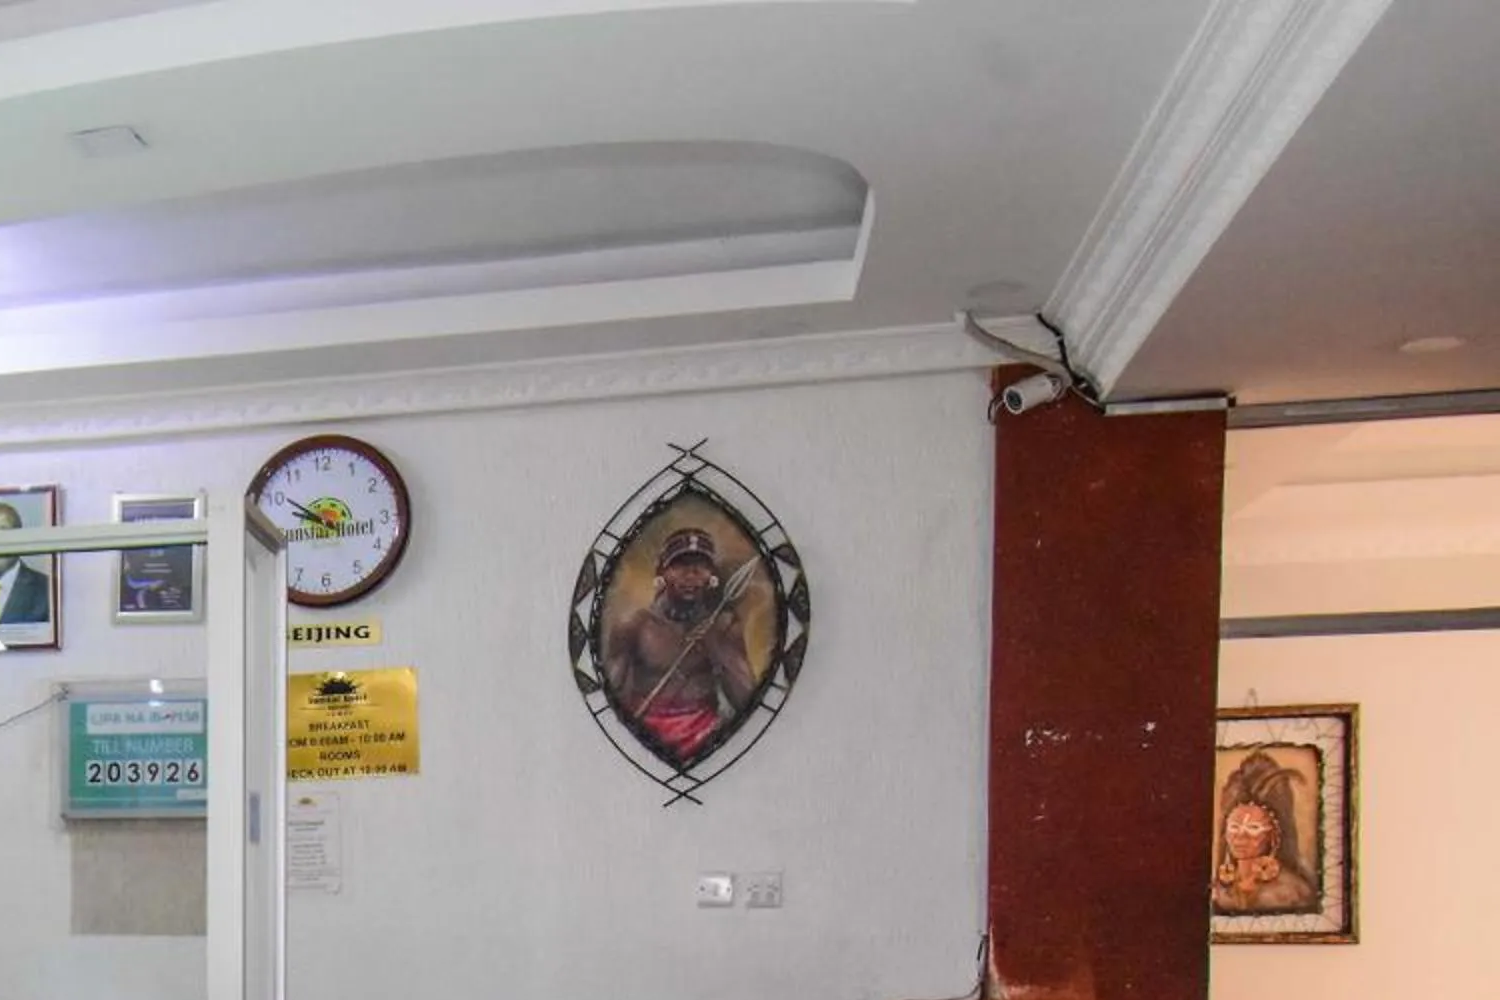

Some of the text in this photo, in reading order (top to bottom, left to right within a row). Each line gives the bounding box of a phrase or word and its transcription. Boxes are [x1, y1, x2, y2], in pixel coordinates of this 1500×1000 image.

[315, 455, 331, 472] 12
[368, 477, 377, 493] 2
[286, 525, 331, 542] unstar
[292, 625, 371, 642] EIJING
[88, 762, 199, 783] 203926
